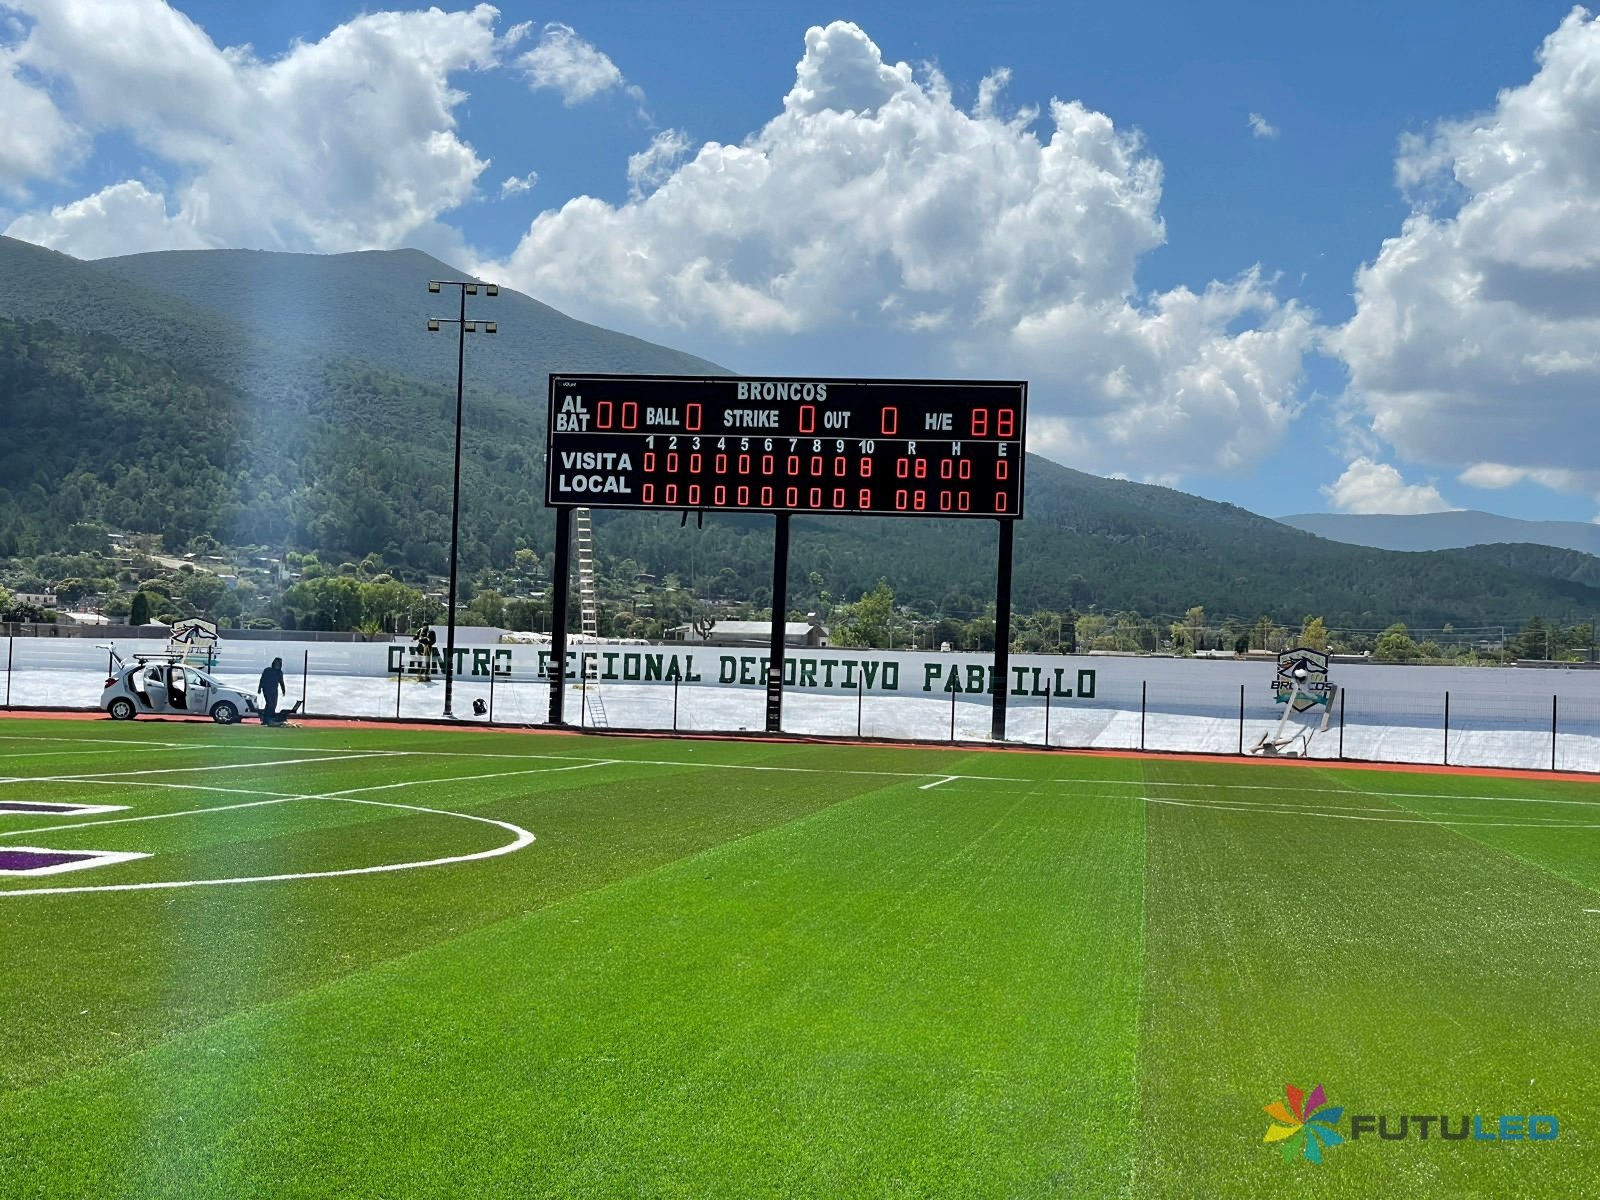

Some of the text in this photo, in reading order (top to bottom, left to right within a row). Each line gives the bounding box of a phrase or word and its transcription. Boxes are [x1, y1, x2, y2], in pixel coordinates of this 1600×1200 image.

[737, 383, 827, 402] BRONCOS
[562, 396, 587, 414] AL
[556, 413, 591, 431] BAT
[646, 407, 680, 426] BALL
[685, 403, 702, 430] 0
[723, 409, 779, 428] STRIKE
[799, 405, 815, 433] 0
[823, 410, 851, 429] OUT
[881, 407, 897, 434] 0
[925, 413, 953, 431] H/E
[645, 435, 1008, 457] 1 2 3 4 5 6 7 8 9 10 R H E
[561, 451, 632, 471] VISITA
[643, 452, 655, 472] 0
[667, 453, 678, 473] 0
[690, 454, 701, 473] 0
[716, 454, 726, 474] 0
[739, 454, 750, 474] 0
[763, 455, 773, 475] 0
[788, 456, 799, 475] 0
[811, 457, 822, 476] 0
[835, 457, 846, 477] 0
[860, 458, 871, 478] 8
[559, 474, 632, 494] LOCAL
[643, 484, 653, 503] 0
[666, 484, 677, 504] 0
[689, 485, 700, 504] 0
[715, 486, 726, 505] 0
[738, 486, 749, 506] 0
[761, 487, 772, 506] 0
[787, 487, 797, 507] 0
[810, 488, 821, 508] 0
[833, 488, 844, 508] 0
[859, 489, 870, 509] 8
[719, 655, 899, 690] DEPORTIVO
[922, 663, 1096, 698] PABILLO
